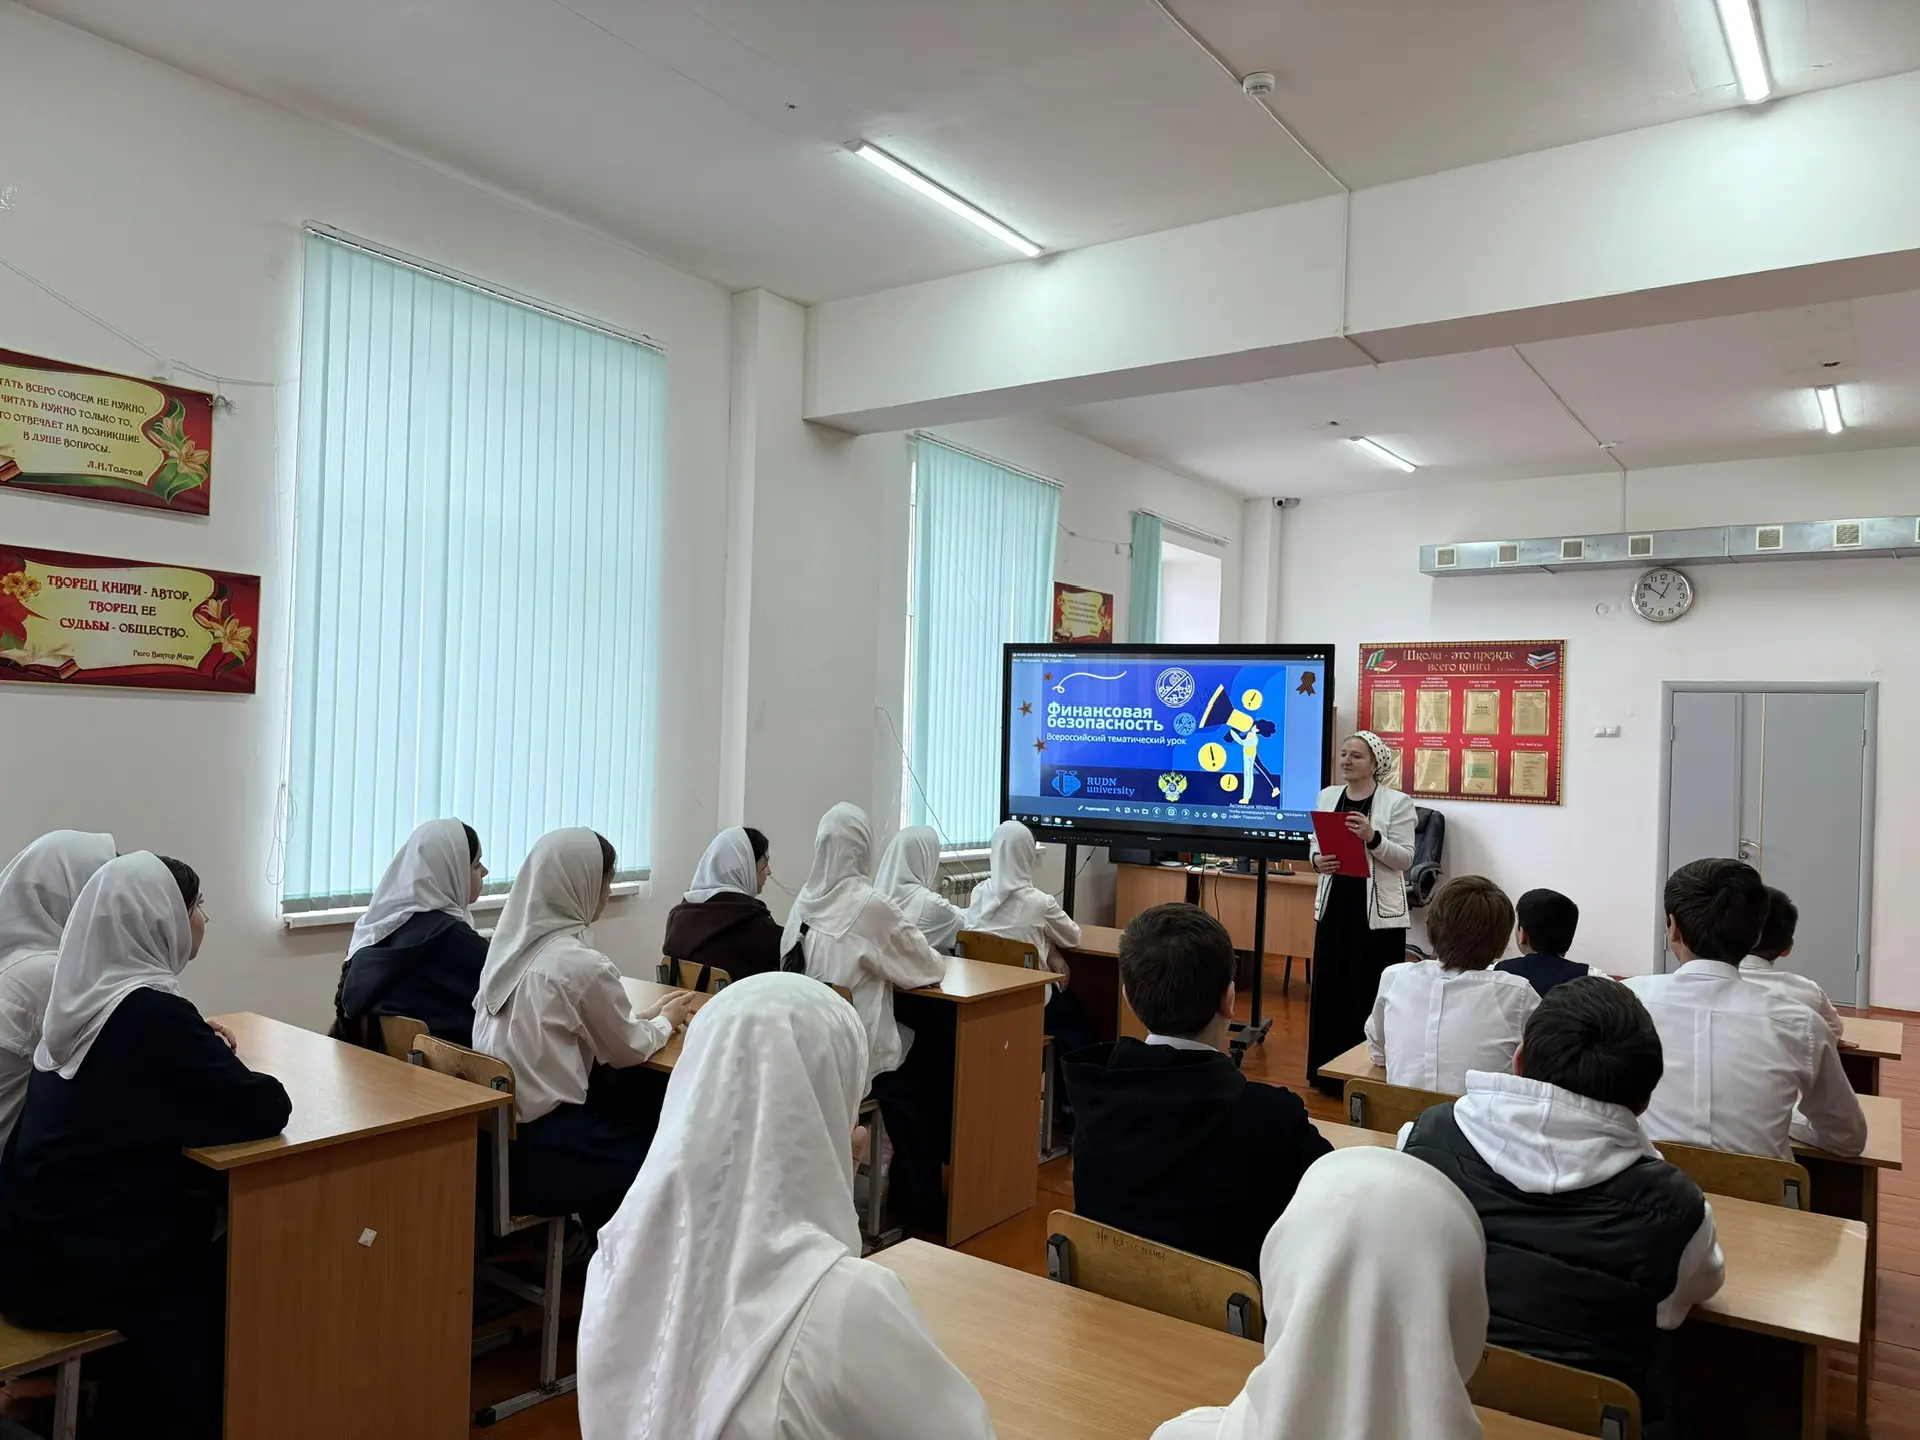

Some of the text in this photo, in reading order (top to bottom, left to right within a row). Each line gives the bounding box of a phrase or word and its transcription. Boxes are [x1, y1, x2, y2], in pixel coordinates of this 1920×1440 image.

[26, 382, 56, 396] ВСЕГО
[58, 389, 94, 404] СОВСЕМ
[96, 397, 110, 406] НЕ
[111, 400, 147, 416] НУЖНО,
[1, 394, 133, 428] ЧИТАТЬ НУЖНО ТОЛЬКО ТО,
[13, 413, 64, 430] ОТВЕЧАЕТ
[66, 423, 79, 433] НА
[82, 426, 140, 444] ВОЗНИКШИЕ
[23, 431, 111, 454] В ДУШЕ ВОПРОСЫ.
[47, 574, 99, 592] ТВОРЕЦ
[102, 580, 142, 596] КНИГИ
[150, 587, 192, 603] АВТОР,
[88, 600, 157, 616] ТВОРЕЦ ЕЕ
[60, 618, 110, 632] СУДЬБЫ
[119, 623, 189, 639] ОБЩЕСТВО.
[152, 651, 176, 660] Виктор
[1403, 650, 1441, 662] Школа
[1451, 651, 1470, 660] это
[1473, 650, 1515, 662] прежде
[1428, 663, 1457, 672] всего
[1047, 701, 1152, 718] Финансовая
[1047, 715, 1164, 731] безопасность
[1046, 733, 1187, 747] Всероссийский тематический урок
[1087, 777, 1117, 786] RUDN
[1086, 785, 1135, 796] university
